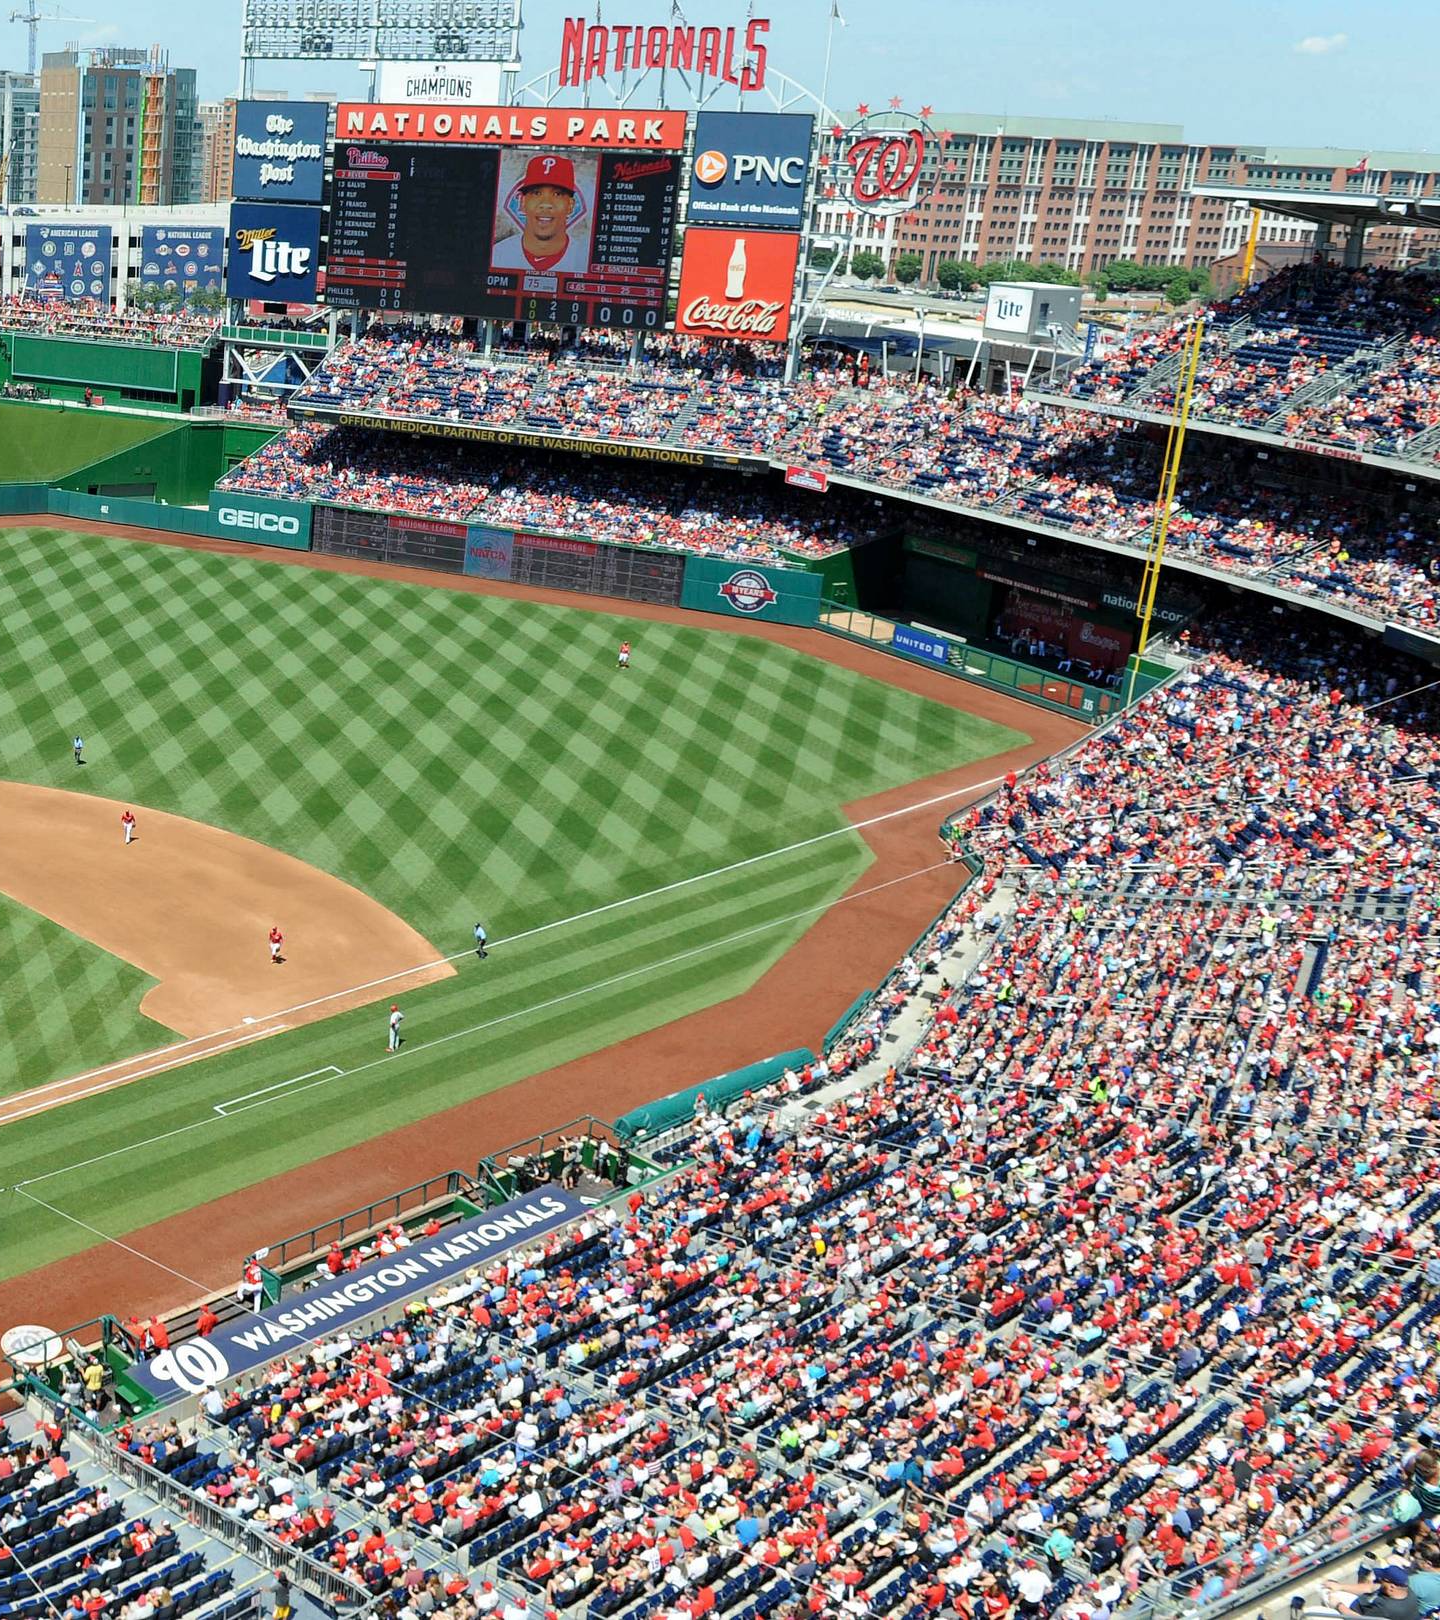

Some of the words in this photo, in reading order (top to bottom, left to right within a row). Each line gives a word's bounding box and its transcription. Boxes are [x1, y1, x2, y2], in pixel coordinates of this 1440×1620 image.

[559, 18, 770, 91] NATIONALS
[406, 78, 472, 98] CHAMPIONS
[265, 114, 294, 134] The
[347, 112, 548, 138] NATIONALS
[568, 117, 665, 142] PARK
[236, 134, 321, 161] Washington
[346, 147, 389, 170] Phillies
[542, 157, 557, 175] P
[847, 129, 925, 202] W
[259, 163, 295, 185] Post
[733, 154, 805, 184] PNC
[616, 182, 633, 190] SPAN
[692, 201, 719, 211] Official
[721, 202, 740, 212] Bank
[740, 203, 748, 213] of
[749, 204, 761, 213] the
[762, 204, 799, 215] Nationals
[613, 214, 638, 222] HARPER
[50, 229, 78, 238] AMERICAN
[78, 229, 99, 238] LEAGUE
[167, 231, 192, 239] NATIONAL
[192, 231, 212, 239] LEAGUE
[612, 225, 650, 234] ZIMMERMAN
[248, 238, 311, 282] Lite
[327, 287, 354, 295] PHILLIES
[381, 288, 386, 297] 0
[394, 289, 400, 298] 0
[326, 297, 360, 306] NATIONALS
[380, 298, 386, 307] 0
[394, 300, 400, 308] 0
[551, 301, 557, 310] 2
[572, 302, 579, 312] 0
[996, 298, 1023, 319] Lite
[549, 311, 556, 320] 4
[571, 313, 578, 323] 0
[600, 307, 611, 322] 0
[622, 309, 633, 324] 0
[645, 310, 656, 326] 0
[683, 295, 784, 333] Coca-Cola
[339, 414, 389, 431] OFFICIAL
[390, 420, 441, 436] MEDICAL
[443, 426, 496, 442] PARTNER
[498, 431, 514, 444] OF
[517, 433, 540, 447] THE
[543, 436, 627, 457] WASHINGTON
[630, 446, 704, 465] NATIONALS
[218, 507, 299, 535] GEICO
[399, 519, 431, 531] NATIONAL
[431, 522, 458, 535] LEAGUE
[521, 535, 559, 547] AMERICAN
[559, 541, 587, 552] LEAGUE
[739, 586, 765, 597] YEARS
[896, 635, 933, 653] UNITED
[230, 1258, 430, 1351] WASHINGTON
[419, 1196, 568, 1268] NATIONALS
[150, 1336, 229, 1394] W
